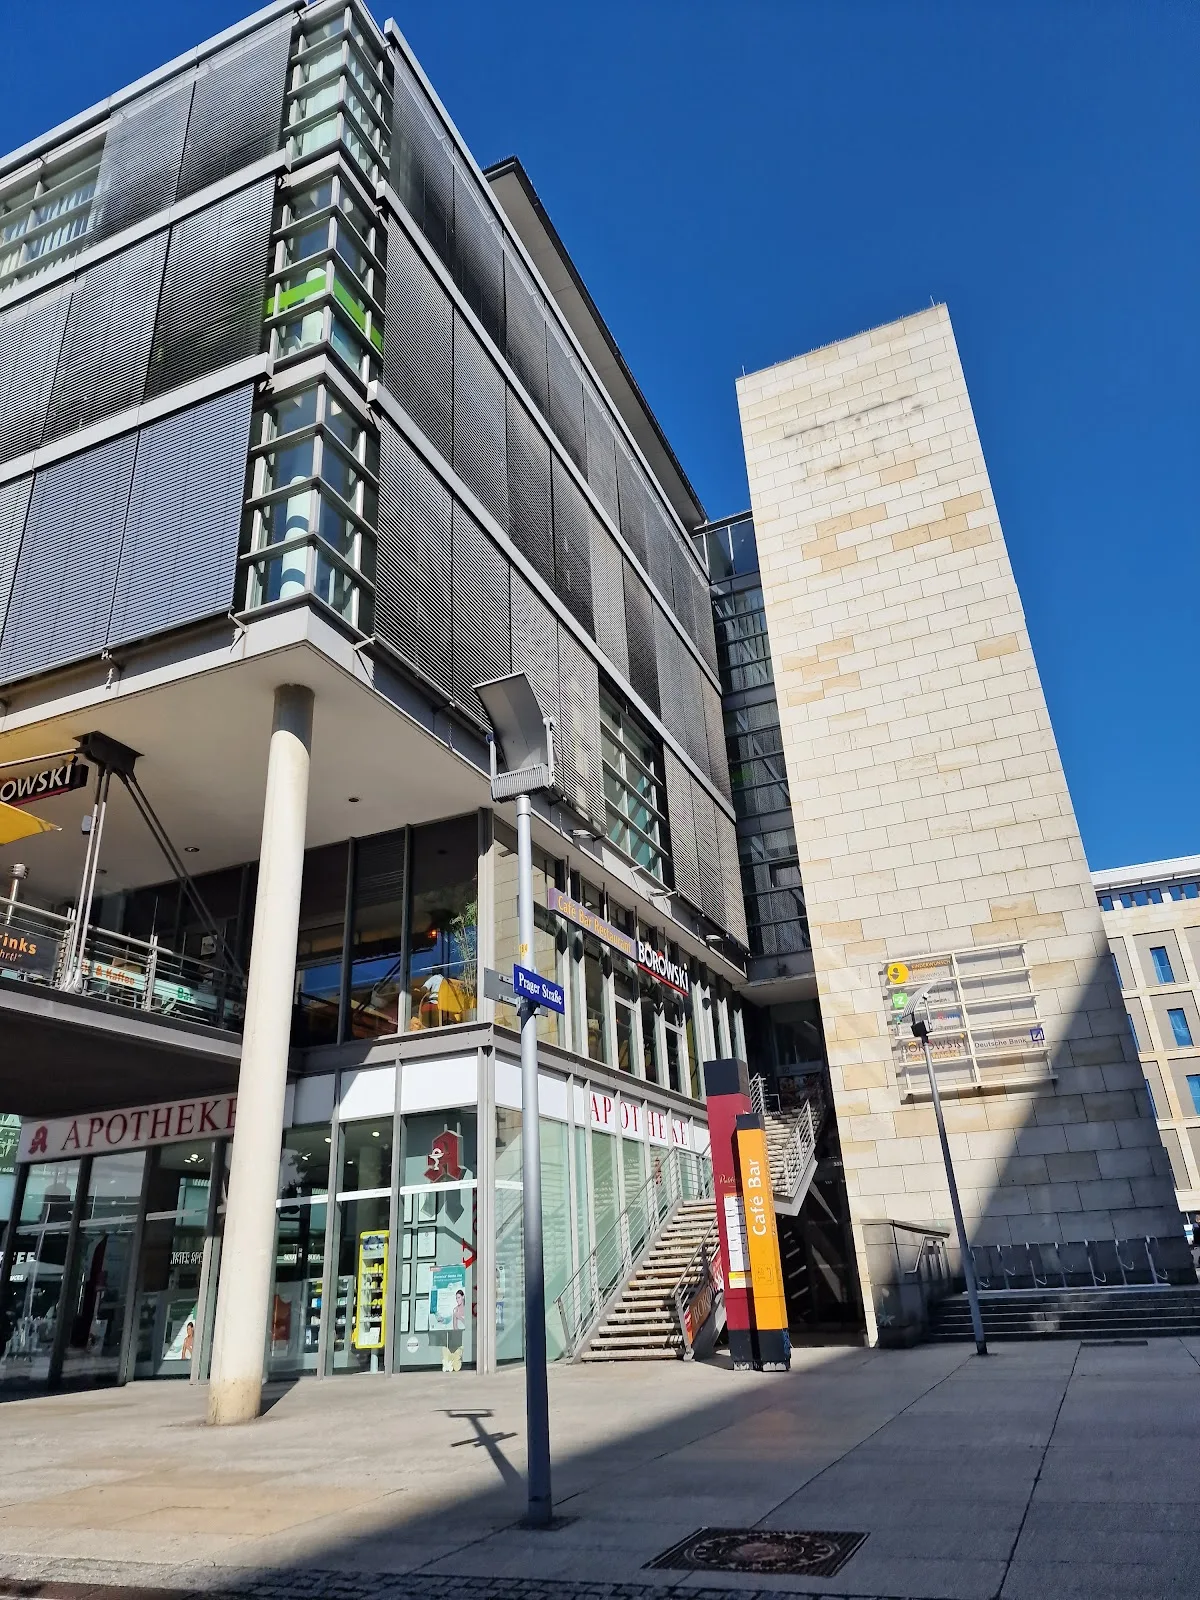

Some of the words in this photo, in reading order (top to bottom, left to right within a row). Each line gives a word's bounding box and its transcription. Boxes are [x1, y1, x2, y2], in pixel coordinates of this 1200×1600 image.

[558, 895, 576, 919] Café
[579, 909, 592, 927] Bar
[594, 918, 632, 954] Restaurant
[638, 941, 689, 993] BOROWSKI
[518, 971, 540, 995] Prager
[541, 984, 562, 1005] Straße
[974, 1039, 1007, 1048] Deutsche
[1009, 1037, 1027, 1045] Bank
[60, 1097, 238, 1151] APOTHEKE
[748, 1157, 762, 1189] Bar
[750, 1195, 767, 1236] Café
